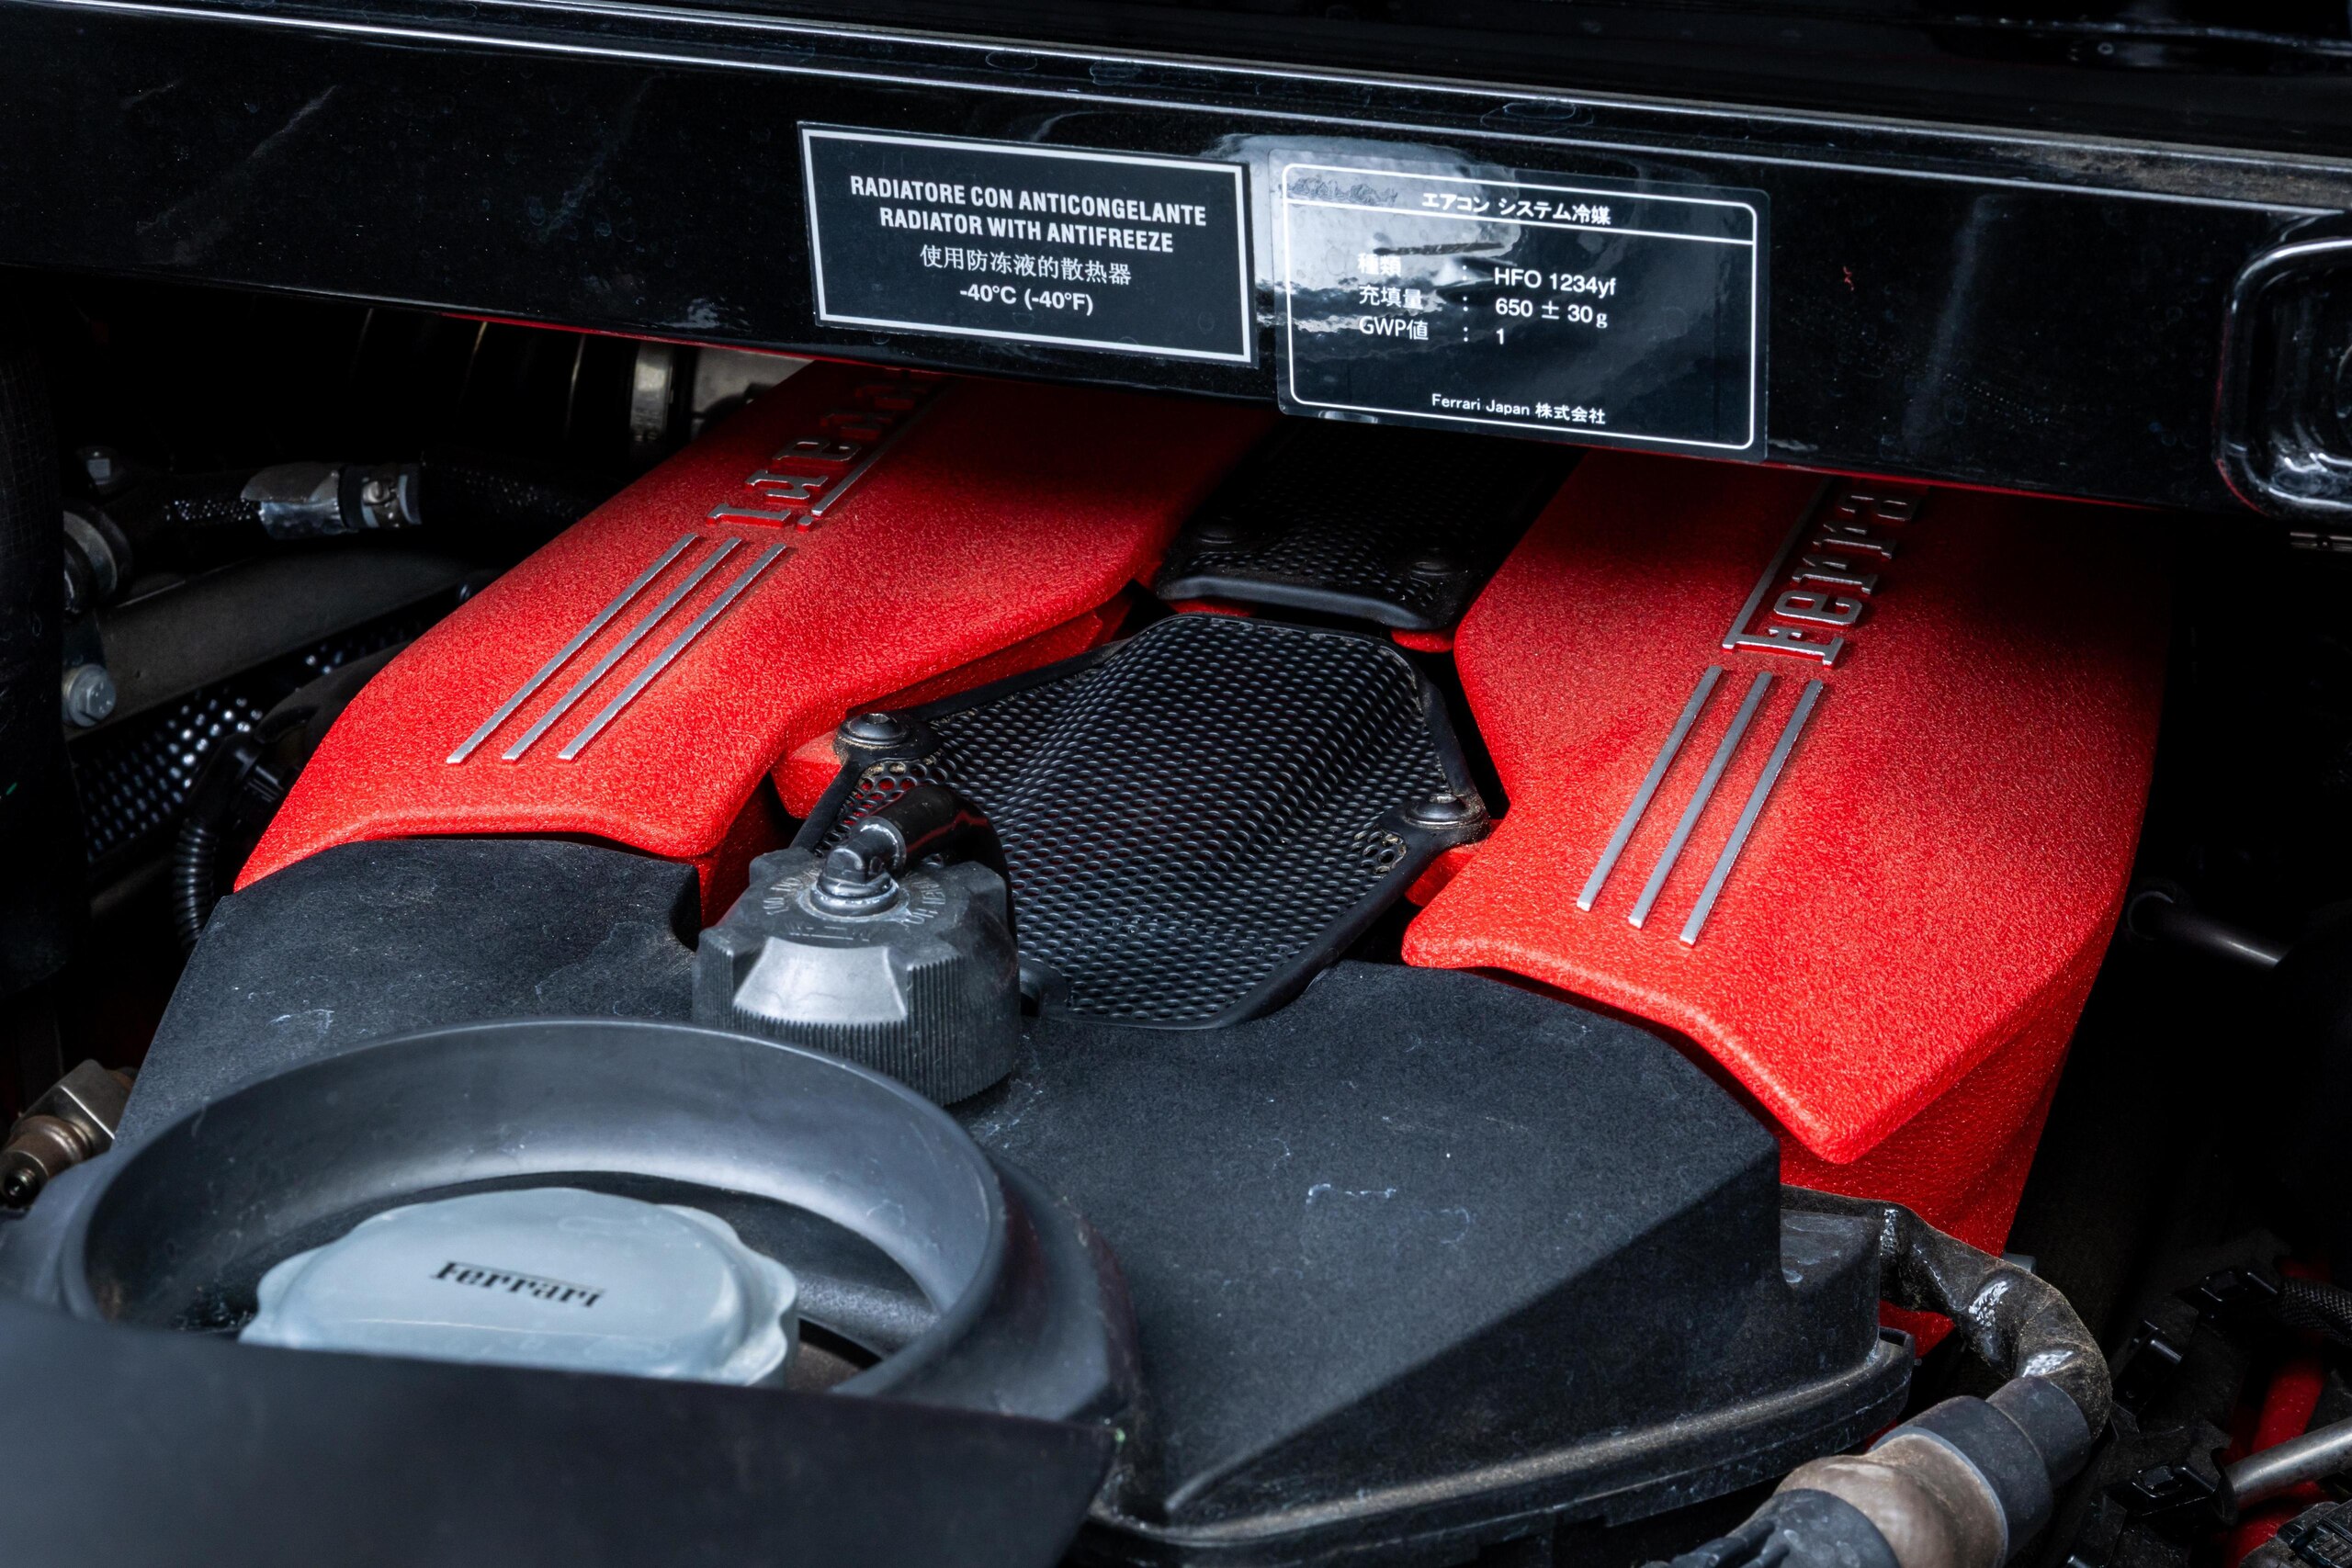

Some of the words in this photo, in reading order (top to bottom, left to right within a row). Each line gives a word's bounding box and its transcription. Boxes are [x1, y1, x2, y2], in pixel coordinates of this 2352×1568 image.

[850, 175, 967, 205] RADIATORE
[970, 186, 1013, 209] CON
[1018, 190, 1207, 227] ANTICONGELANTE
[1421, 192, 1490, 213] エアコン
[1498, 197, 1611, 226] システム冷媒
[879, 207, 984, 236] RADIATOR
[986, 216, 1042, 241] WITH
[1046, 222, 1174, 254] ANTIFREEZE
[920, 243, 1132, 286] 使用防冻液的散热器
[1494, 266, 1543, 288] HFO
[1548, 272, 1617, 299] 1234yf
[959, 285, 1017, 305] -40°C
[1023, 288, 1093, 317] (-40°F)
[1359, 285, 1424, 310] 充填量
[1495, 297, 1533, 318] 650
[1359, 315, 1430, 341] GWP値
[1496, 327, 1505, 345] 1
[1430, 392, 1481, 410] Ferrari
[1485, 400, 1531, 417] Japan
[1534, 401, 1606, 425] 株式会社
[1722, 476, 1926, 669] Ferra
[430, 1260, 605, 1308] Ferrari
